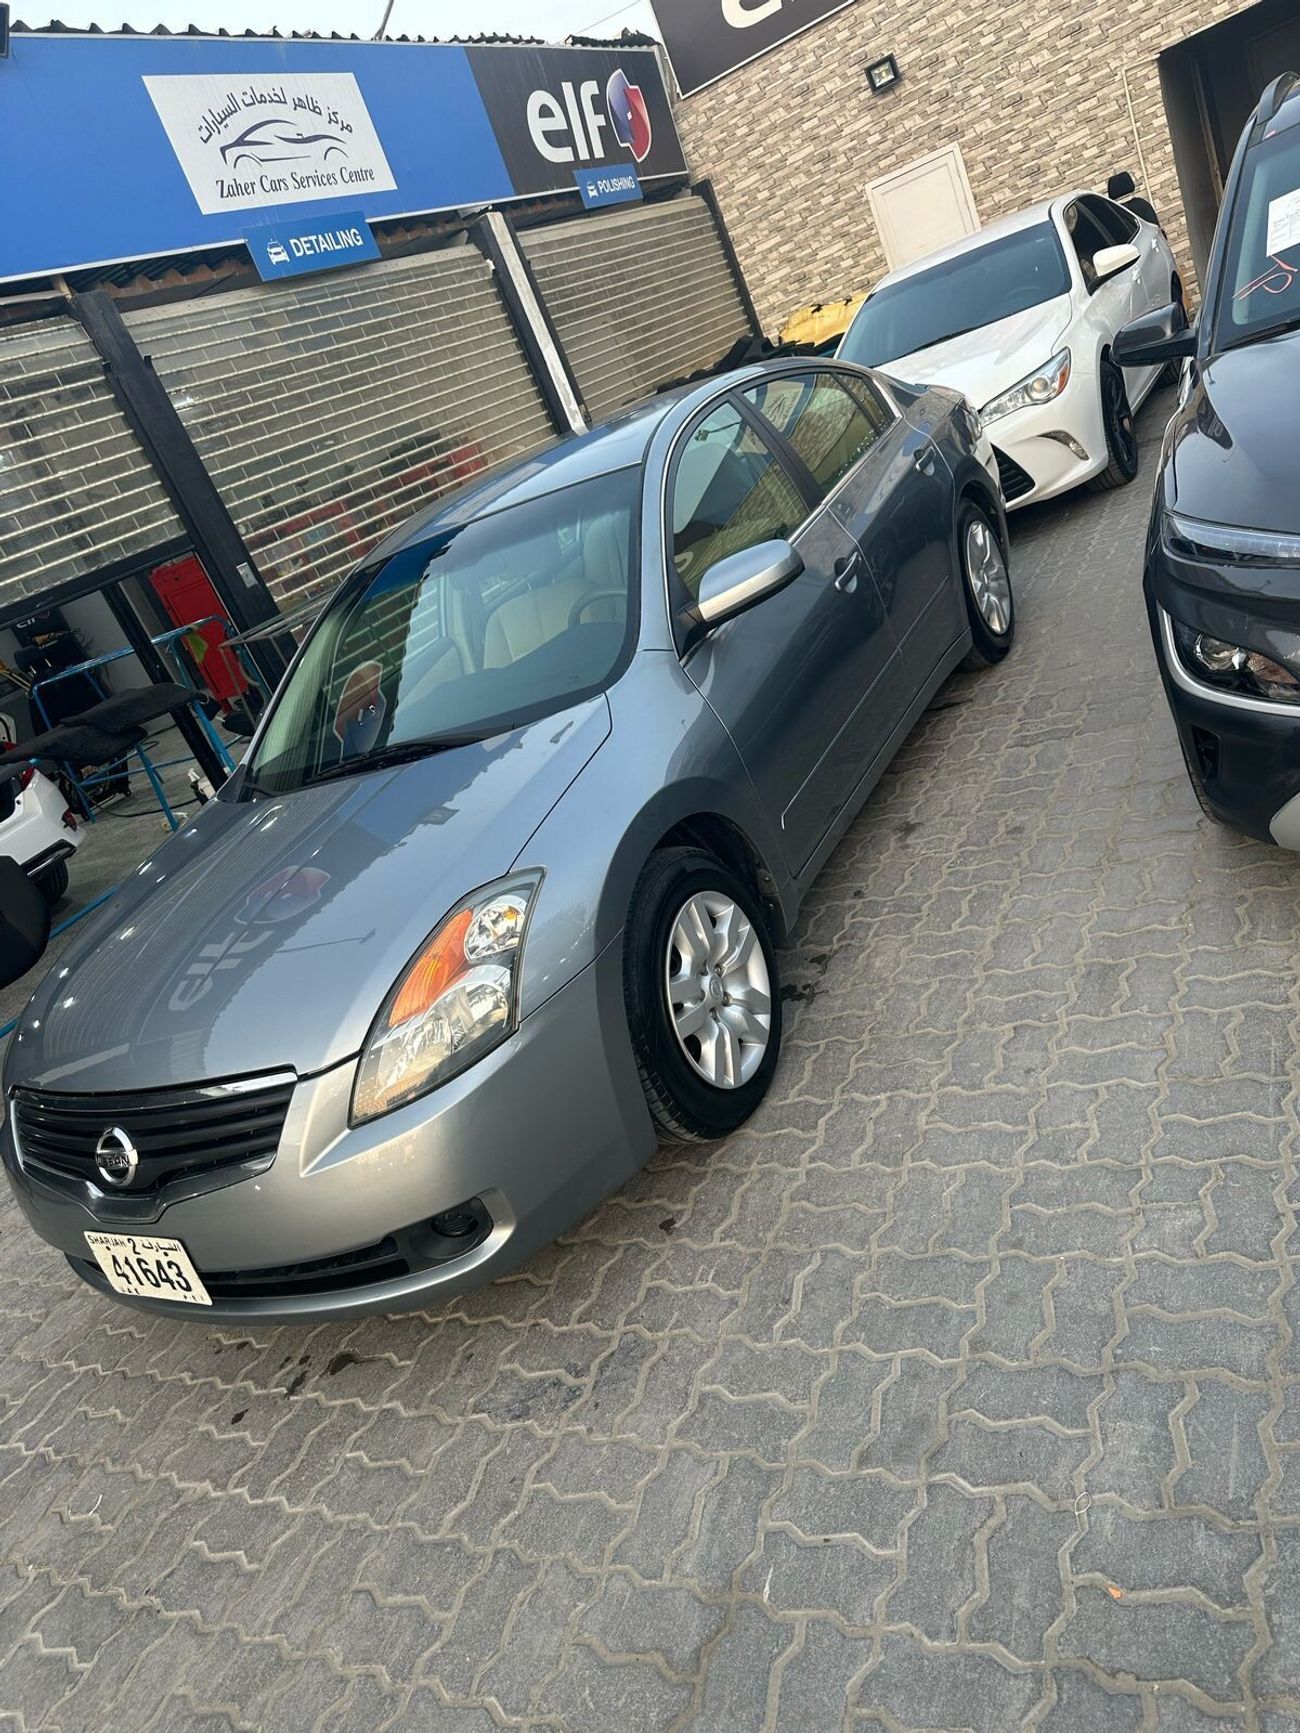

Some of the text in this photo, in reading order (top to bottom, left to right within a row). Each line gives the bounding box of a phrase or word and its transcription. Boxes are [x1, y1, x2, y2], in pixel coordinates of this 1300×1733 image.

[198, 86, 353, 144] مركز ظاهر لخدمات السيارات
[526, 80, 606, 163] elf
[216, 165, 375, 198] Zaher Cars Services Centre
[597, 175, 636, 194] POLISHING
[289, 228, 363, 257] DETAILING
[87, 1234, 141, 1255] SHARJAH 2
[111, 1254, 193, 1293] 41643
